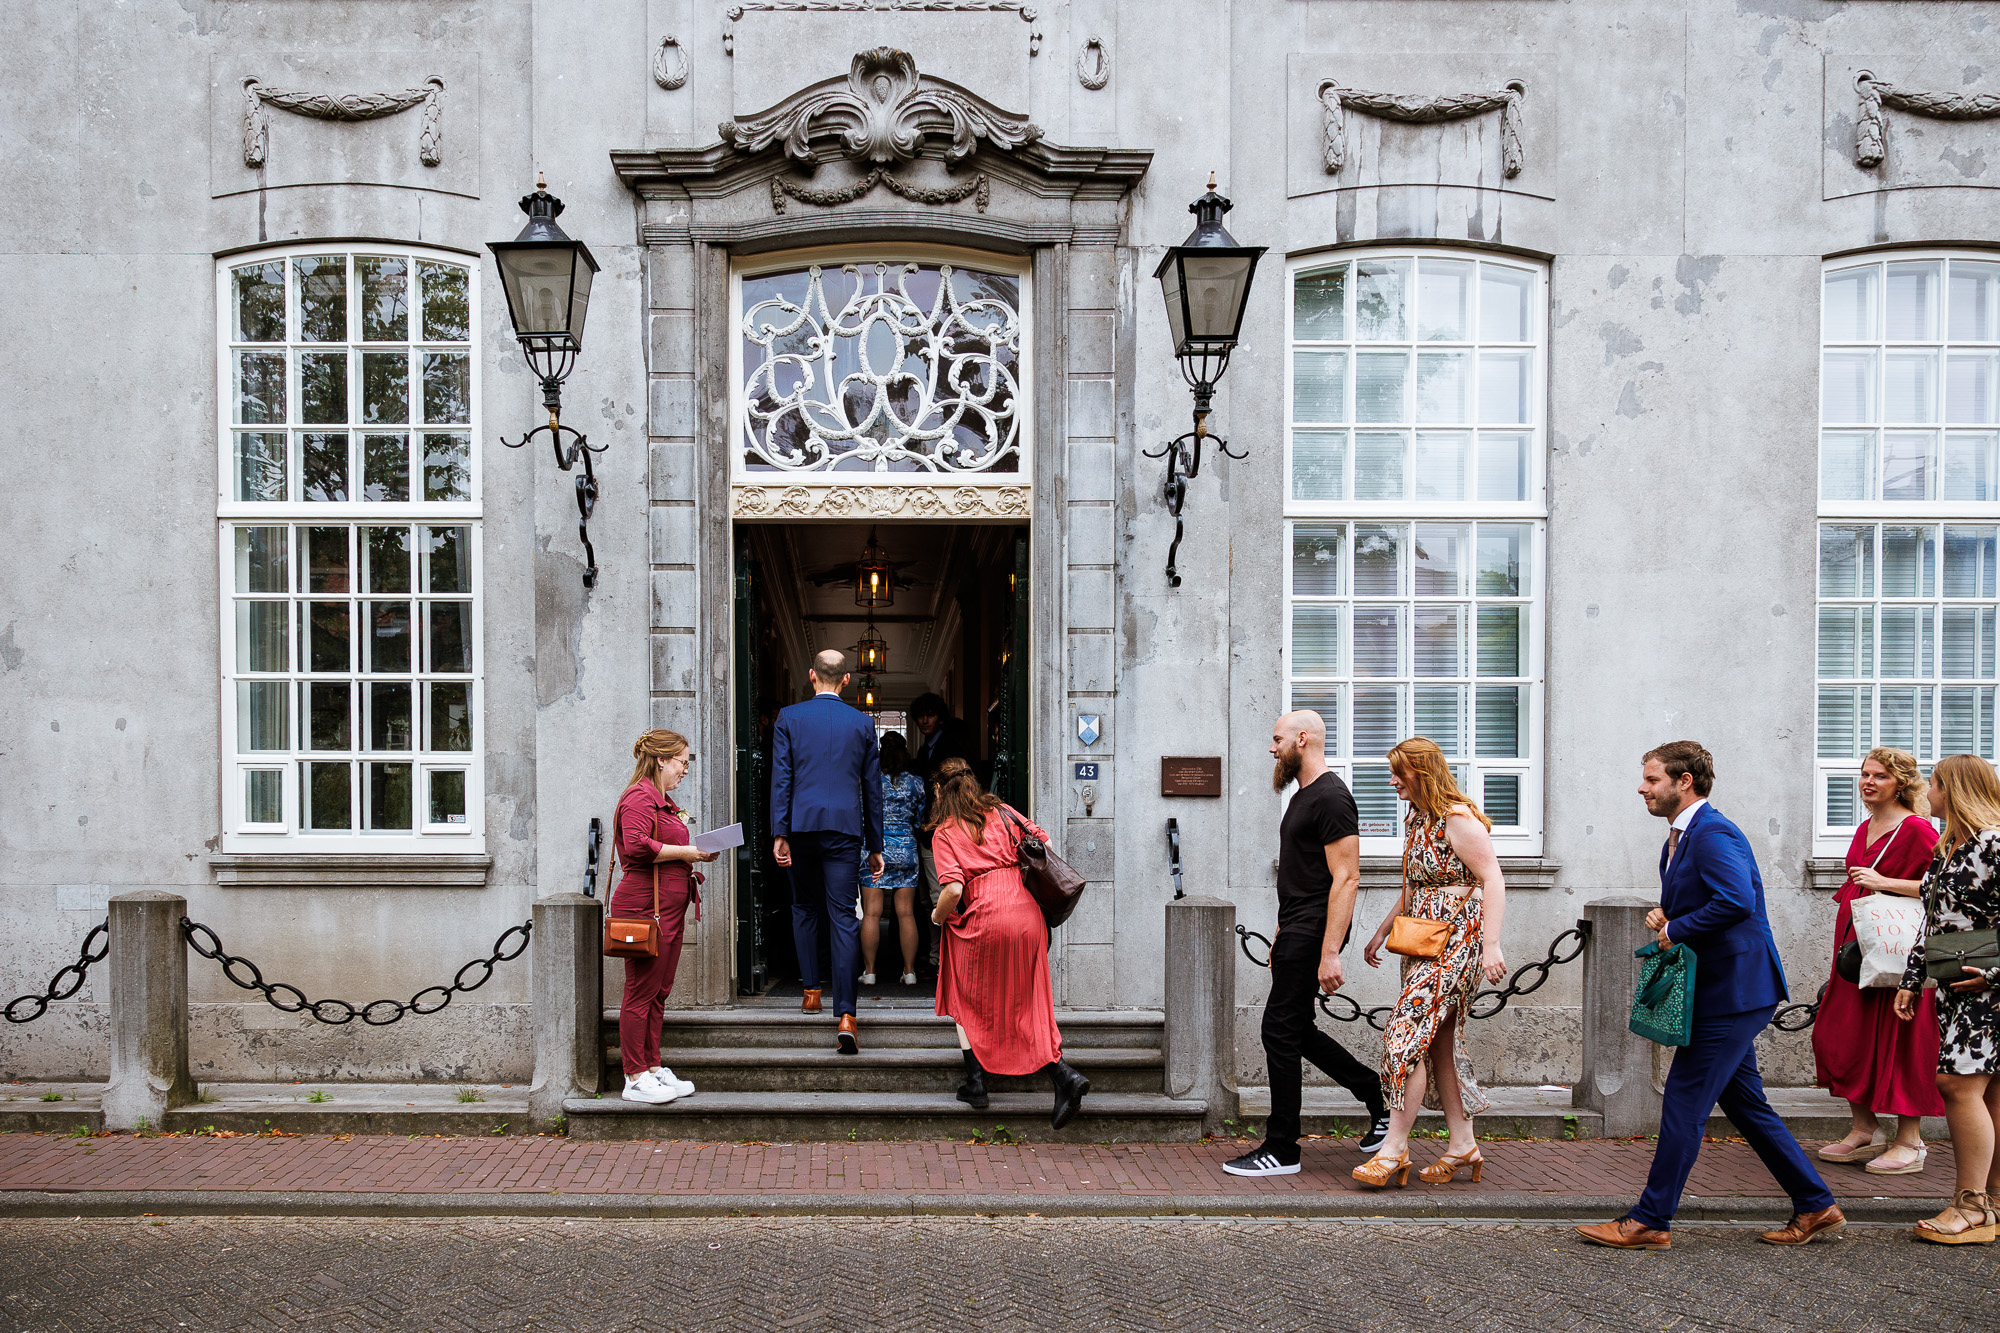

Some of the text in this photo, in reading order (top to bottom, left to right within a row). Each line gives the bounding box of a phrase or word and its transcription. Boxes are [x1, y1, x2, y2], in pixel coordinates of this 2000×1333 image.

[1079, 765, 1095, 777] 43
[1871, 908, 1906, 921] SAY
[1872, 924, 1901, 936] TO
